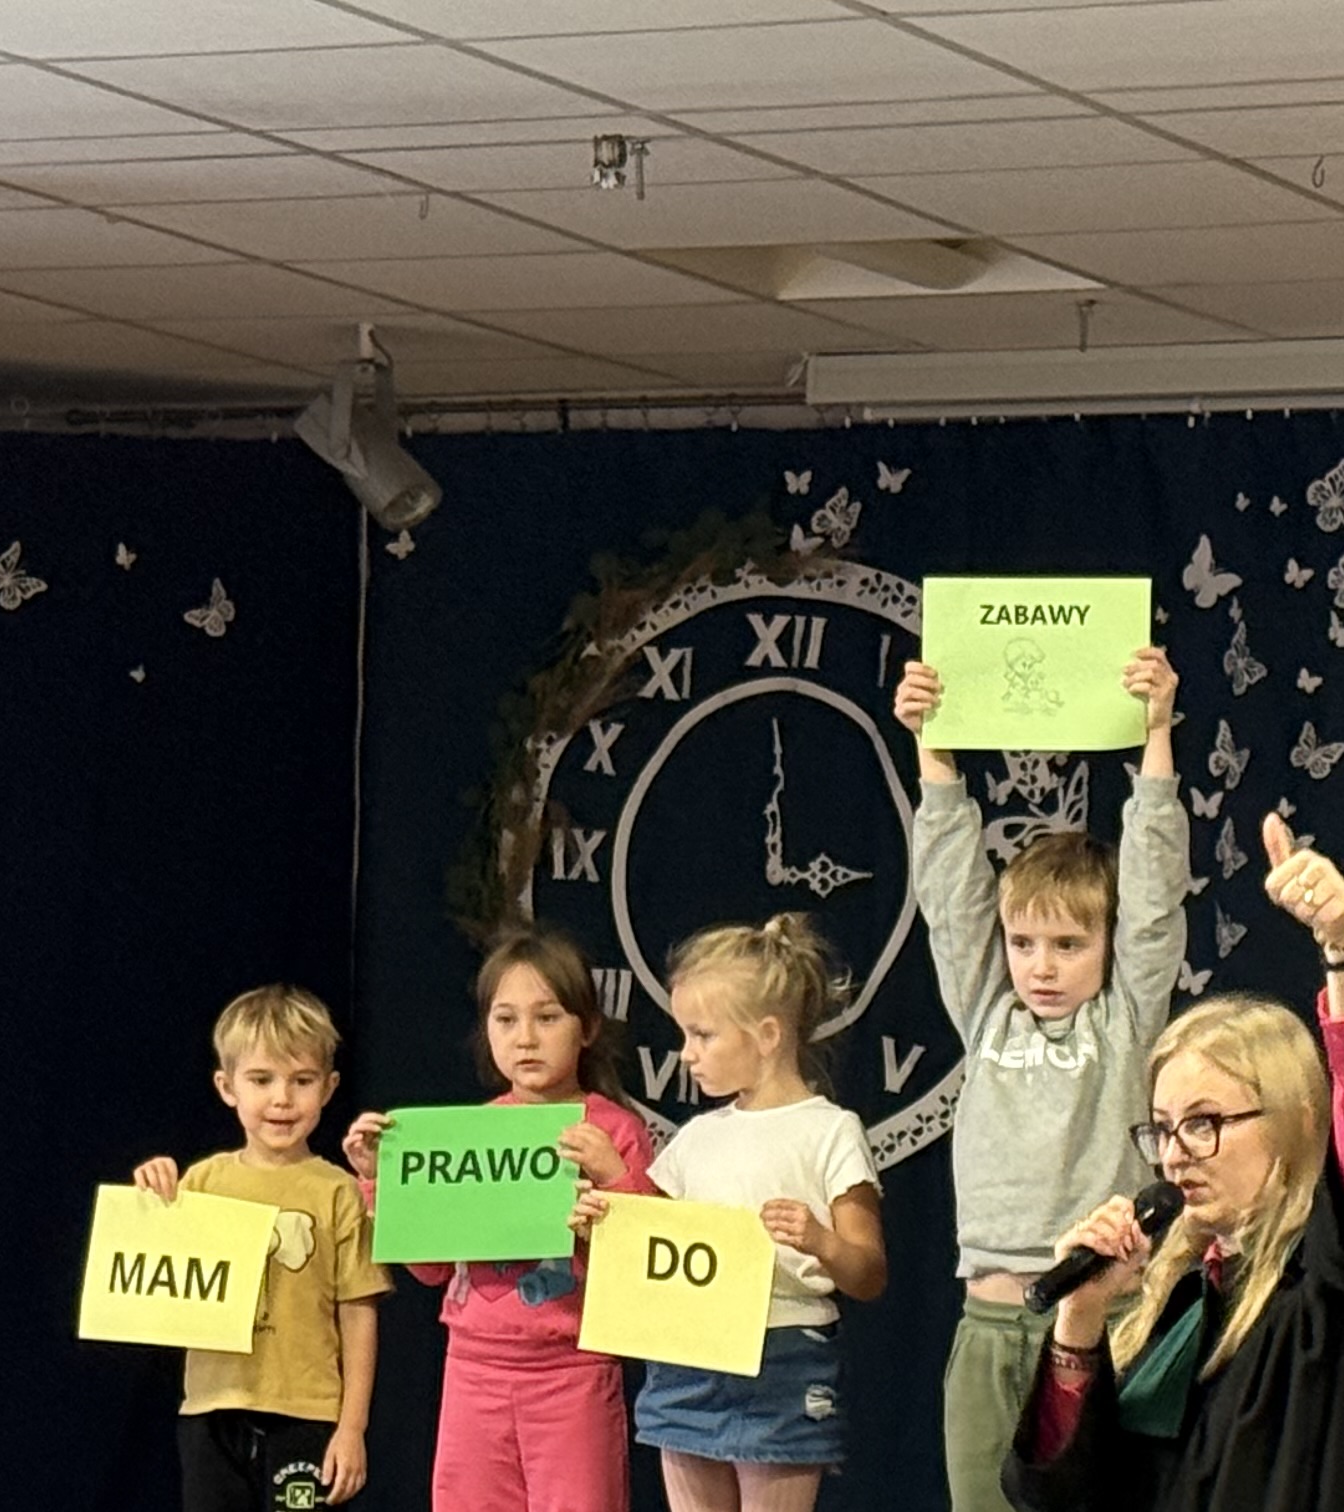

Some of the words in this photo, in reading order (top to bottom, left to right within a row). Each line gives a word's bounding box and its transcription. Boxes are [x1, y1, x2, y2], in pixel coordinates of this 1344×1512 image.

[745, 613, 828, 670] XII
[978, 604, 1091, 627] ZABAWY
[640, 645, 694, 700] XI
[583, 718, 624, 776] X
[552, 827, 606, 883] IX
[400, 1144, 562, 1186] PRAWO
[108, 1251, 231, 1303] MAM
[645, 1235, 719, 1288] DO
